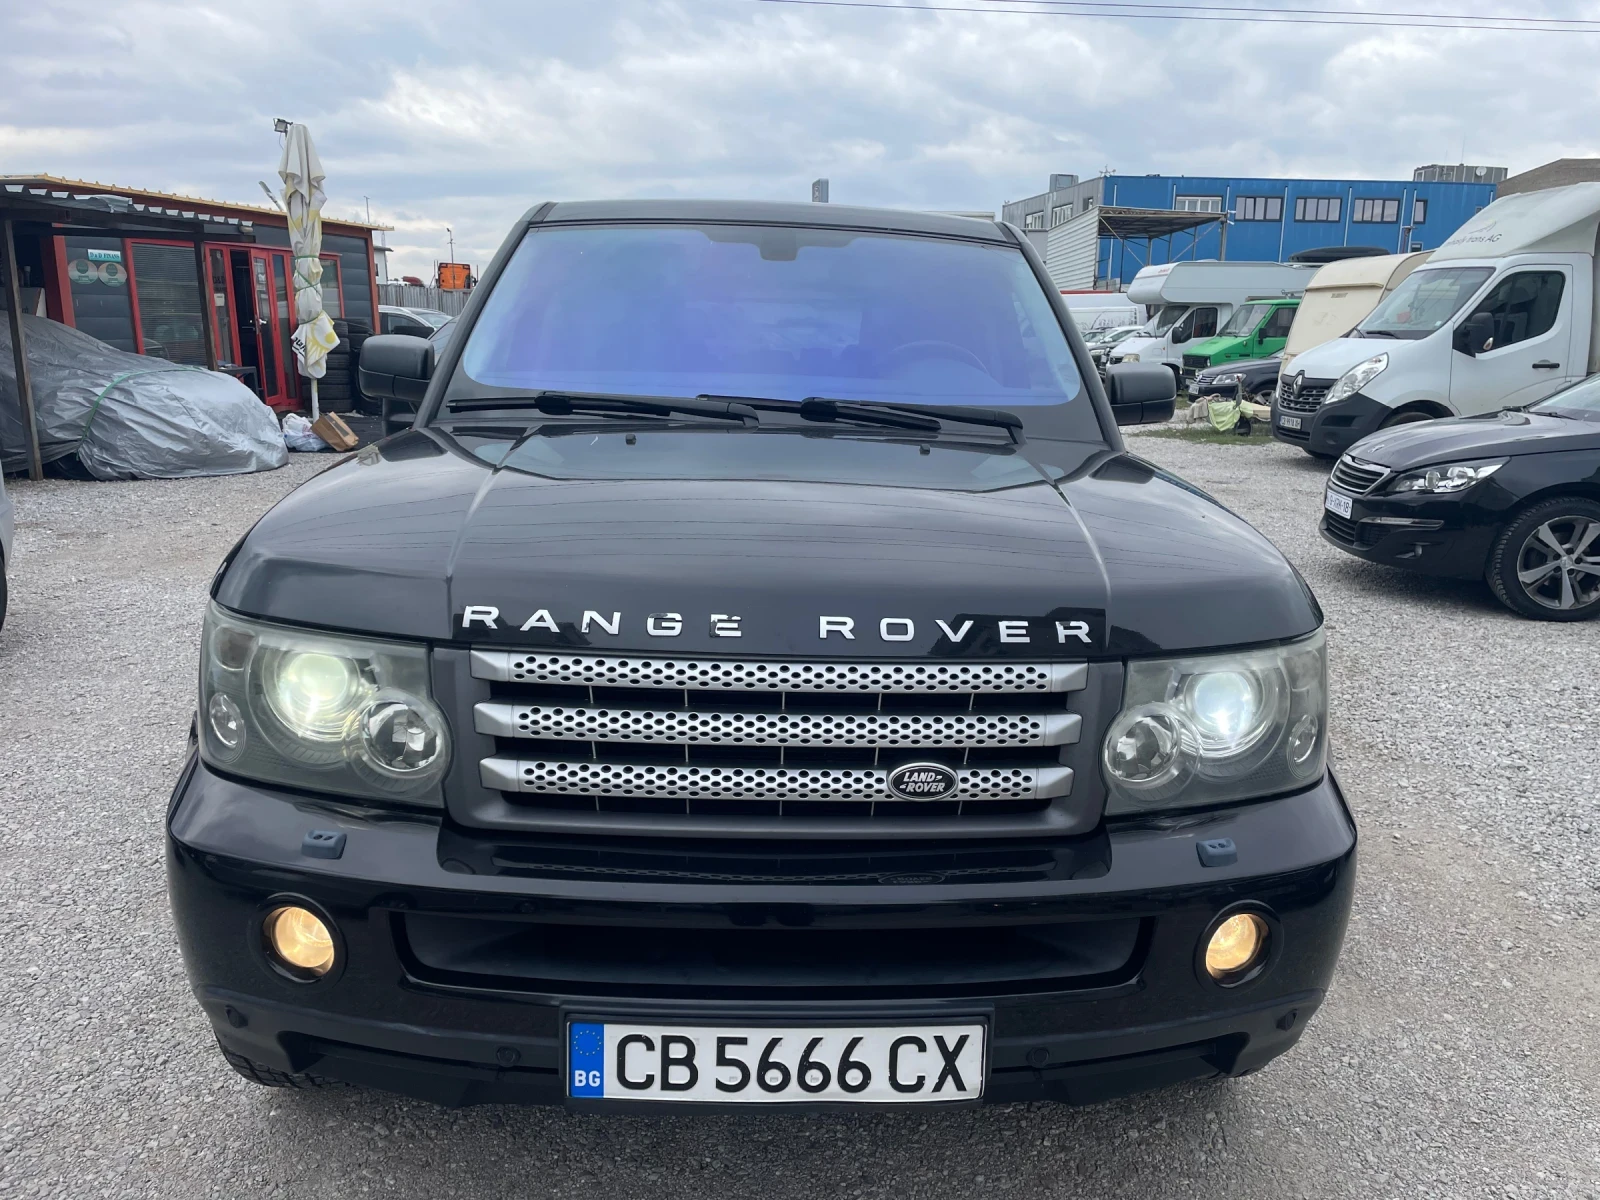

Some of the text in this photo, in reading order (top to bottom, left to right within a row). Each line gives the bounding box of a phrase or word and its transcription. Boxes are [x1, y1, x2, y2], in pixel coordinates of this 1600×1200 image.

[1486, 234, 1503, 242] AG
[461, 606, 1093, 644] RANGE ROVER
[616, 1033, 970, 1094] CB 5666 CX
[574, 1069, 601, 1088] BG
